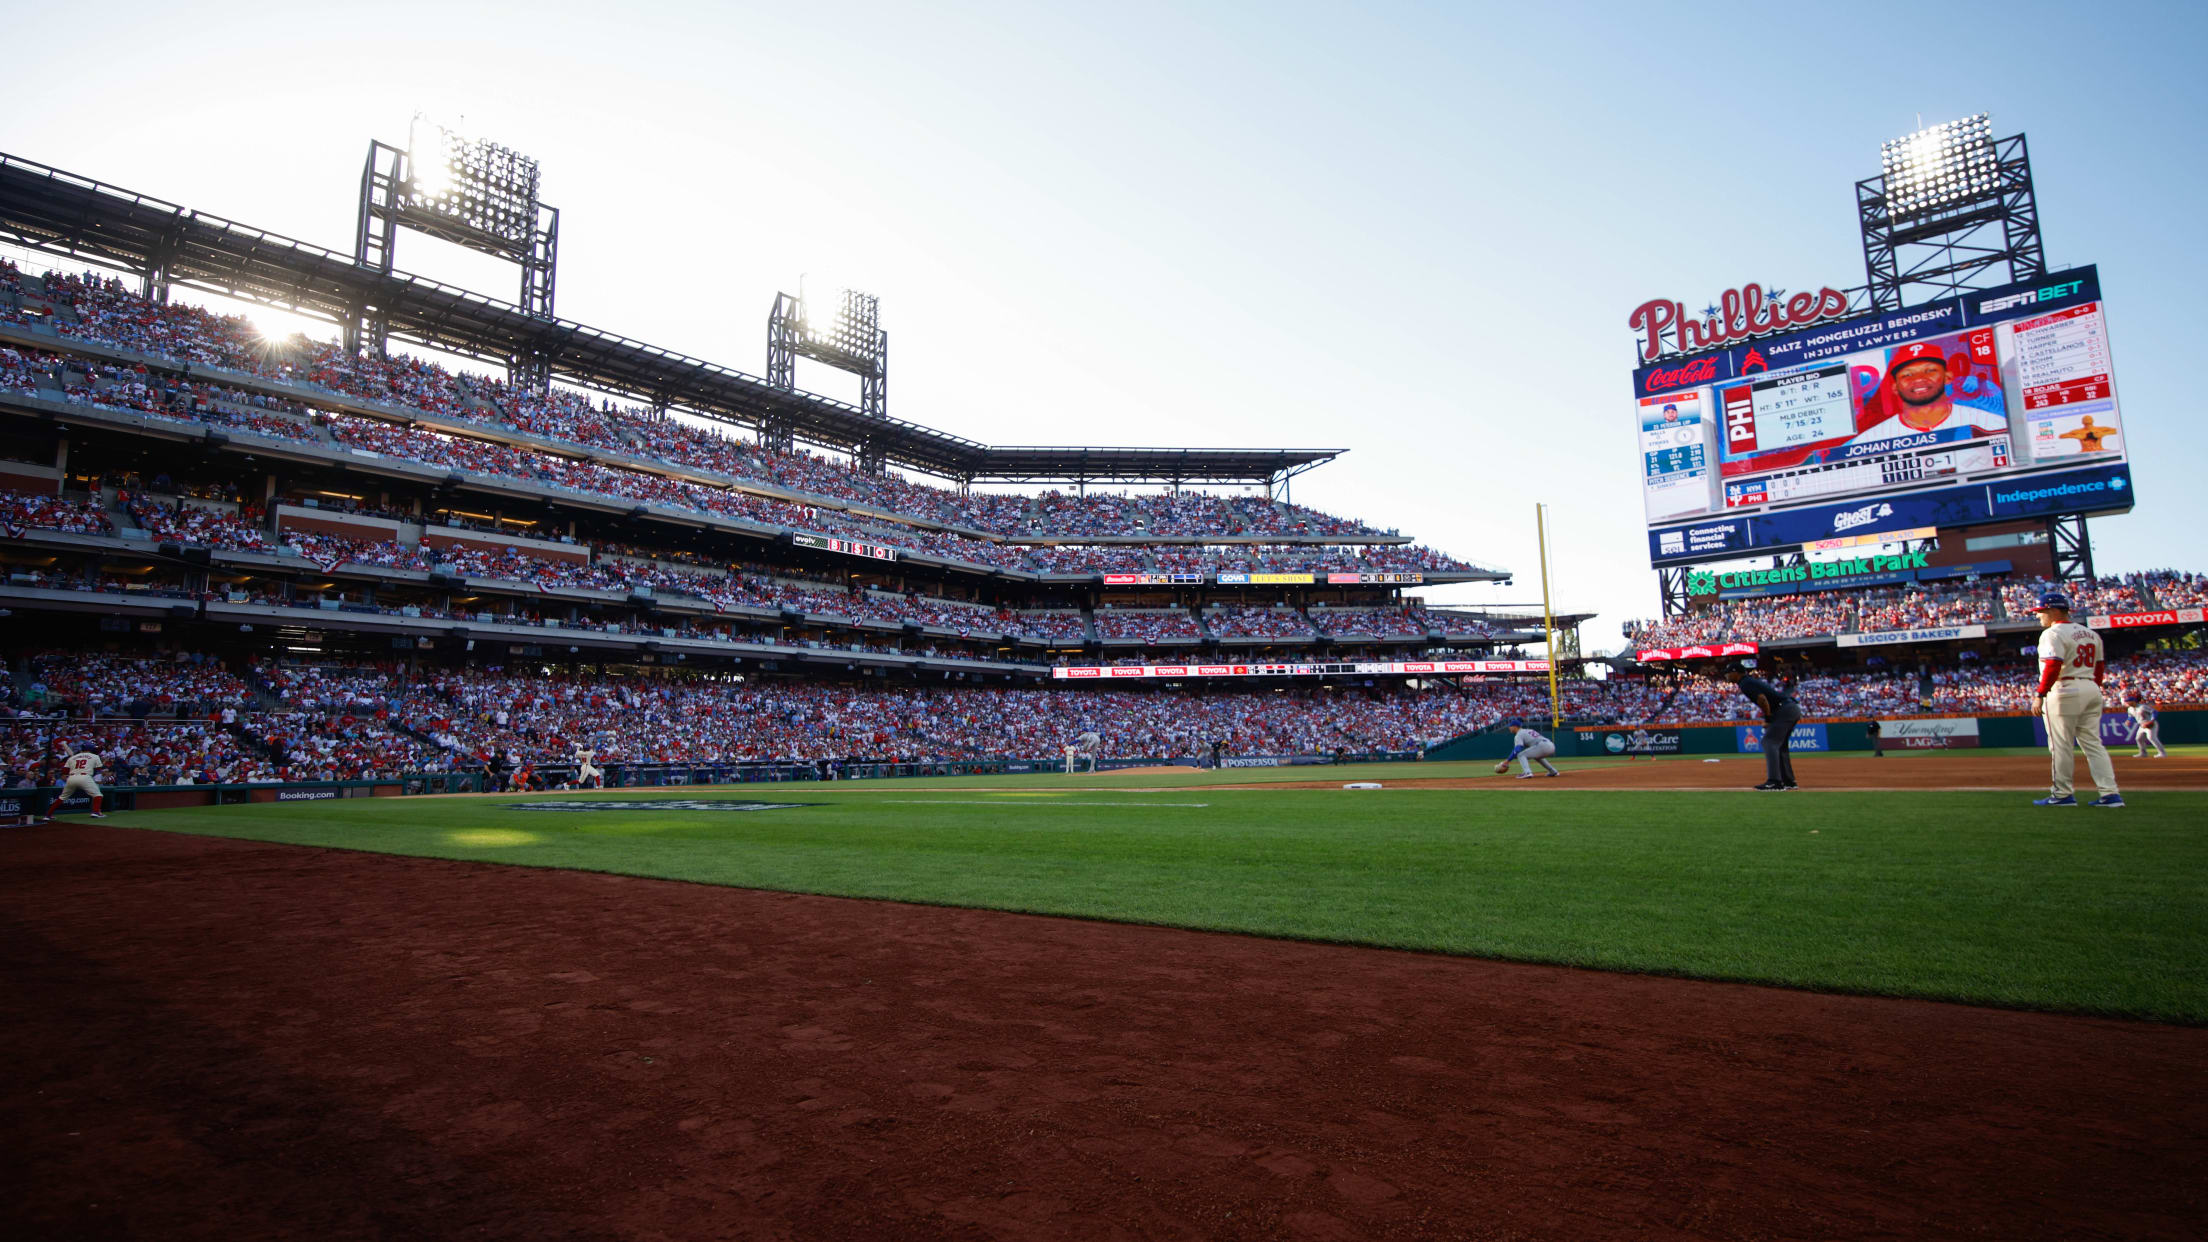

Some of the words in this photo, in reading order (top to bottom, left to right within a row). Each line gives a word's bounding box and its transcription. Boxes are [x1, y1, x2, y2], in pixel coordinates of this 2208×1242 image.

[1980, 291, 2037, 314] ESPN
[2037, 280, 2084, 302] BET
[1629, 283, 1849, 360] Phillies
[1769, 341, 1802, 356] SALTZ
[1806, 323, 1883, 347] MONGELUZZI
[1888, 307, 1953, 329] BENDESKY
[2025, 320, 2074, 337] SCHWARBER
[1803, 344, 1849, 360] INJURY
[1858, 329, 1918, 348] LAWYERS
[1971, 332, 1990, 345] CF
[2027, 333, 2056, 344] TURNER
[1975, 345, 1991, 356] 18
[2028, 340, 2057, 351] HARPER
[2029, 341, 2085, 358] CASTELLANOS
[2031, 362, 2054, 371] STOTT
[2031, 366, 2074, 379] REALMUTO
[1645, 356, 1719, 392] Coca-Cola
[1777, 374, 1805, 387] PLAYER
[1806, 372, 1820, 381] BIO
[2032, 376, 2060, 385] MARSH
[2033, 384, 2060, 393] ROJAS
[1827, 391, 1843, 399] 165
[1780, 412, 1796, 420] MLB
[1798, 407, 1826, 418] DEBUT:
[1727, 399, 1754, 442] PHI
[1786, 434, 1806, 442] AGE:
[1812, 430, 1824, 438] 24
[1845, 440, 1890, 457] JOHAN
[1892, 433, 1937, 449] ROJAS
[1746, 485, 1762, 493] NYM
[1996, 479, 2104, 504] Independence
[1748, 494, 1762, 503] PHI
[1834, 504, 1880, 532] GHOST
[1689, 525, 1736, 536] Connecting
[795, 536, 816, 544] evolv
[1690, 532, 1725, 544] financial
[831, 540, 838, 550] B
[854, 544, 861, 555] S
[1691, 541, 1726, 552] services.
[1719, 565, 1807, 588] Citizens
[1810, 556, 1872, 579] Bank
[1872, 551, 1928, 572] Park
[1221, 574, 1245, 582] GOYA
[2113, 613, 2174, 625] TOYOTA
[1858, 632, 1908, 644] LISCIO'S
[1911, 629, 1961, 640] BAKERY
[1693, 646, 1712, 657] BEAM
[1734, 642, 1755, 654] BEAM
[1652, 649, 1671, 660] BEAM
[2073, 643, 2096, 668] 38
[1228, 758, 1278, 768] POSTSEASON
[280, 792, 335, 800] Booking.com
